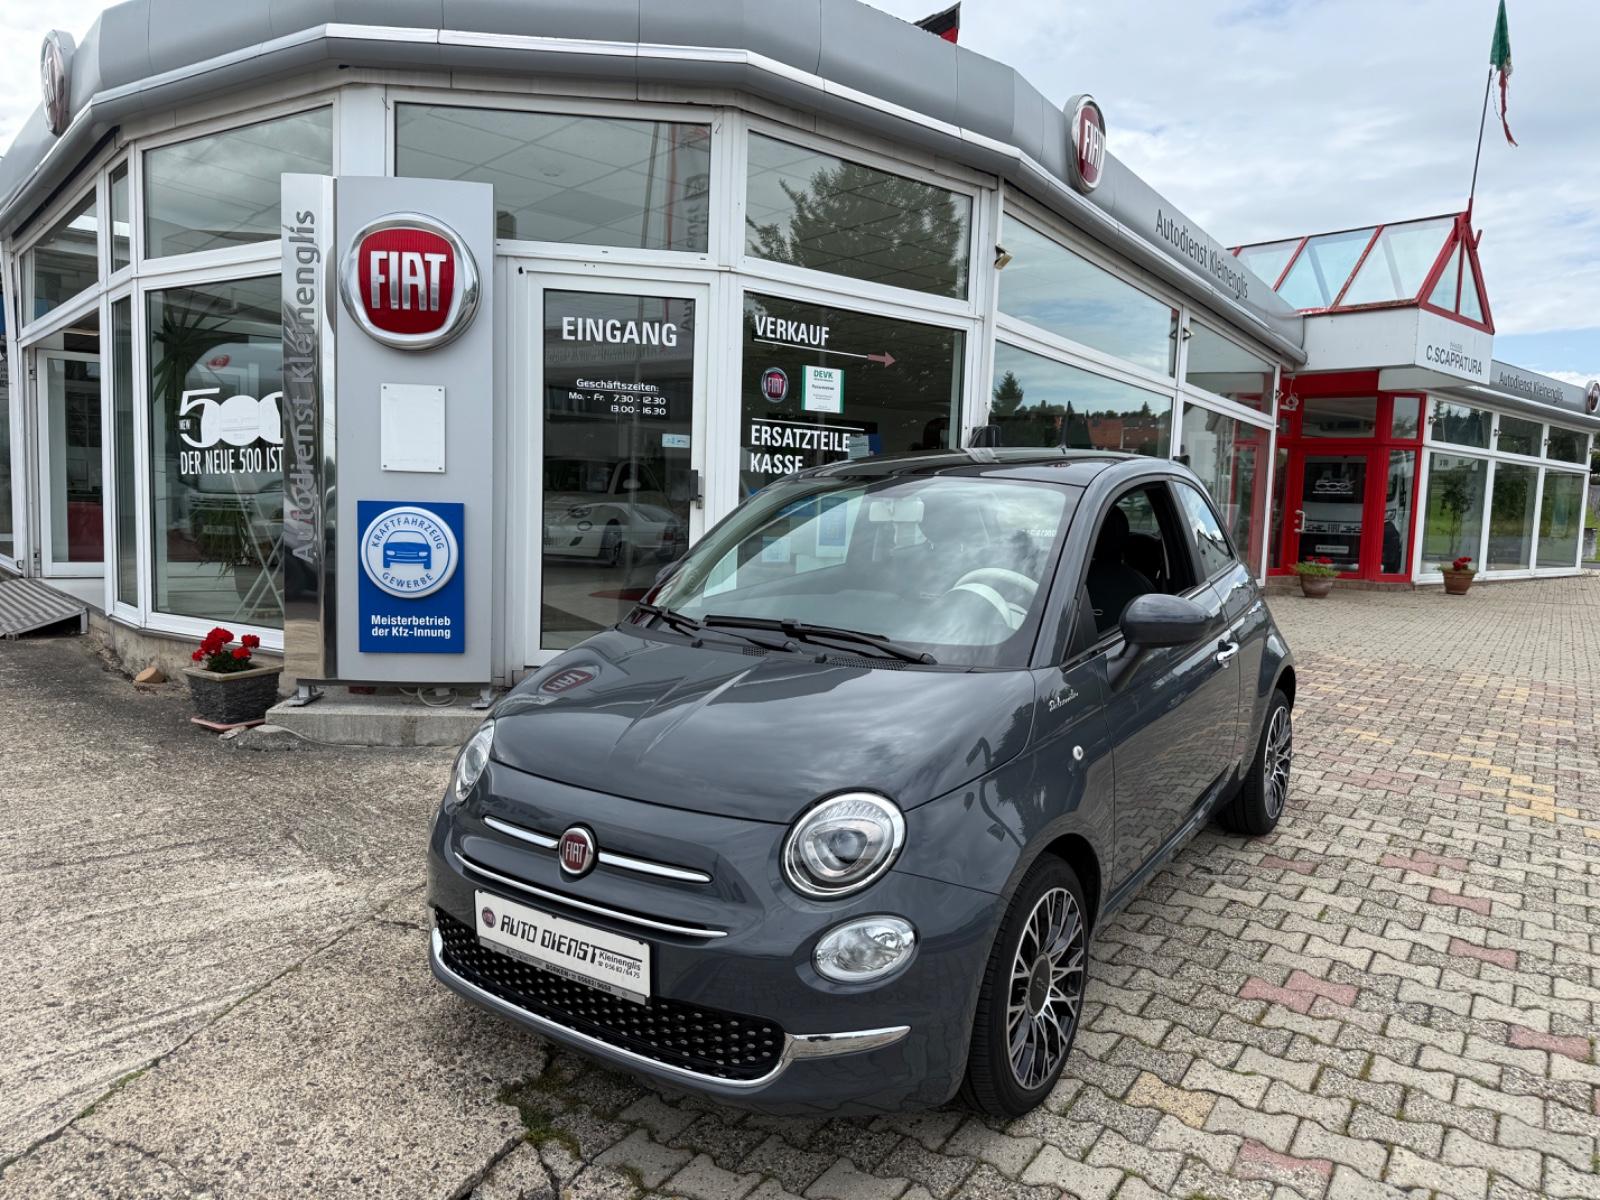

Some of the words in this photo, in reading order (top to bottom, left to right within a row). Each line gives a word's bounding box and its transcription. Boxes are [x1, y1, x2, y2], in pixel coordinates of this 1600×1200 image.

[1155, 209, 1208, 269] Autodienst
[1209, 249, 1248, 300] Kleinenglis
[370, 250, 447, 312] FIAT
[288, 210, 321, 383] Kleinenglis
[562, 316, 677, 347] EINGANG
[755, 314, 830, 346] VERKAUF
[1426, 345, 1482, 376] C.SCAPPATURA
[576, 379, 660, 393] Geschäftszeiten:
[813, 369, 834, 380] DEVK
[1498, 371, 1533, 393] Autodienst
[568, 391, 584, 400] Mo.
[593, 393, 605, 401] Fr.
[613, 394, 634, 403] 7.30
[642, 396, 667, 405] 12.30
[610, 404, 635, 413] 13.00
[642, 407, 667, 415] 16.30
[751, 425, 851, 452] ERSATZTEILE
[180, 450, 202, 475] DER
[205, 448, 235, 474] NEUE
[239, 447, 263, 474] 500
[266, 446, 284, 473] IST
[289, 395, 317, 563] Autodienst
[371, 516, 445, 550] KRAFTFAHRZEUG
[382, 572, 434, 589] GEWERBE
[371, 614, 451, 626] Meisterbetrieb
[371, 627, 389, 637] der
[391, 627, 451, 640] Kfz-Innung
[565, 840, 586, 864] FIAT
[500, 915, 538, 943] AUTO
[540, 930, 598, 965] DIENST
[599, 951, 641, 971] Kleinenglis
